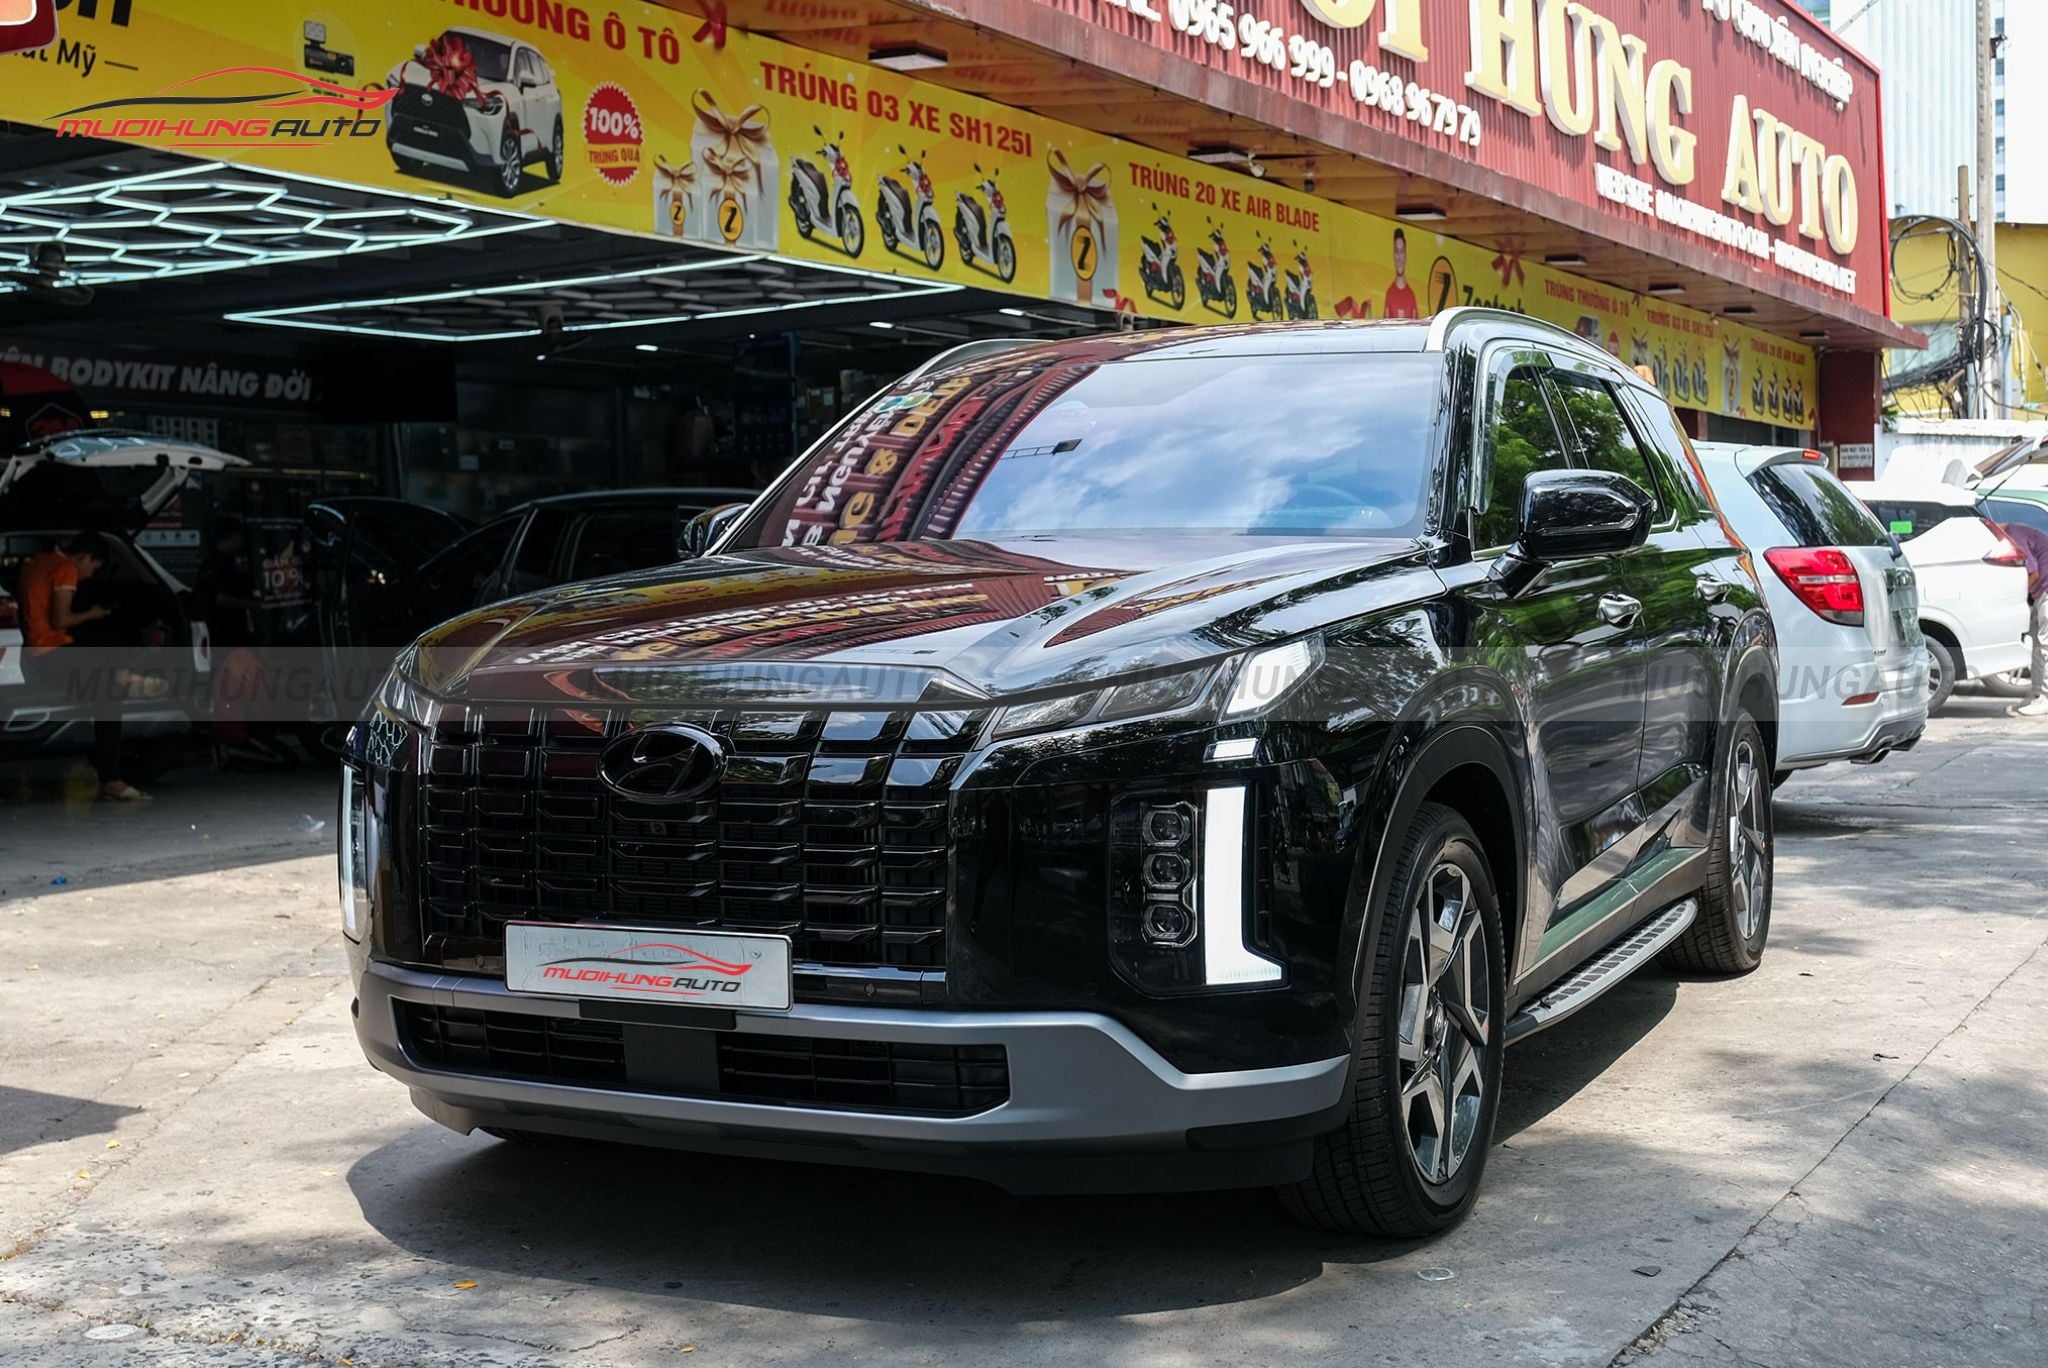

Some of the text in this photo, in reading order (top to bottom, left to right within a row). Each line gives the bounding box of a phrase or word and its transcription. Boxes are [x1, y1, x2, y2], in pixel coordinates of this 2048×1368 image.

[56, 37, 97, 77] Mỹ
[604, 11, 626, 50] Ô
[638, 26, 680, 65] TÔ
[1168, 0, 1236, 50] 0965
[1239, 13, 1286, 71] 966
[1289, 35, 1335, 88] 999
[1350, 59, 1404, 117] 0968
[588, 106, 640, 140] 100%
[760, 62, 1032, 158] TRÚNG 03 XE SH125I
[1128, 162, 1320, 232] TRÚNG 20 XE AIR BLADE
[1721, 94, 1858, 257] AUTO
[51, 356, 175, 391] BODYKIT
[180, 361, 259, 398] NÂNG
[264, 367, 312, 400] ĐỜI
[543, 965, 741, 993] MUOIHUNGAUTO
